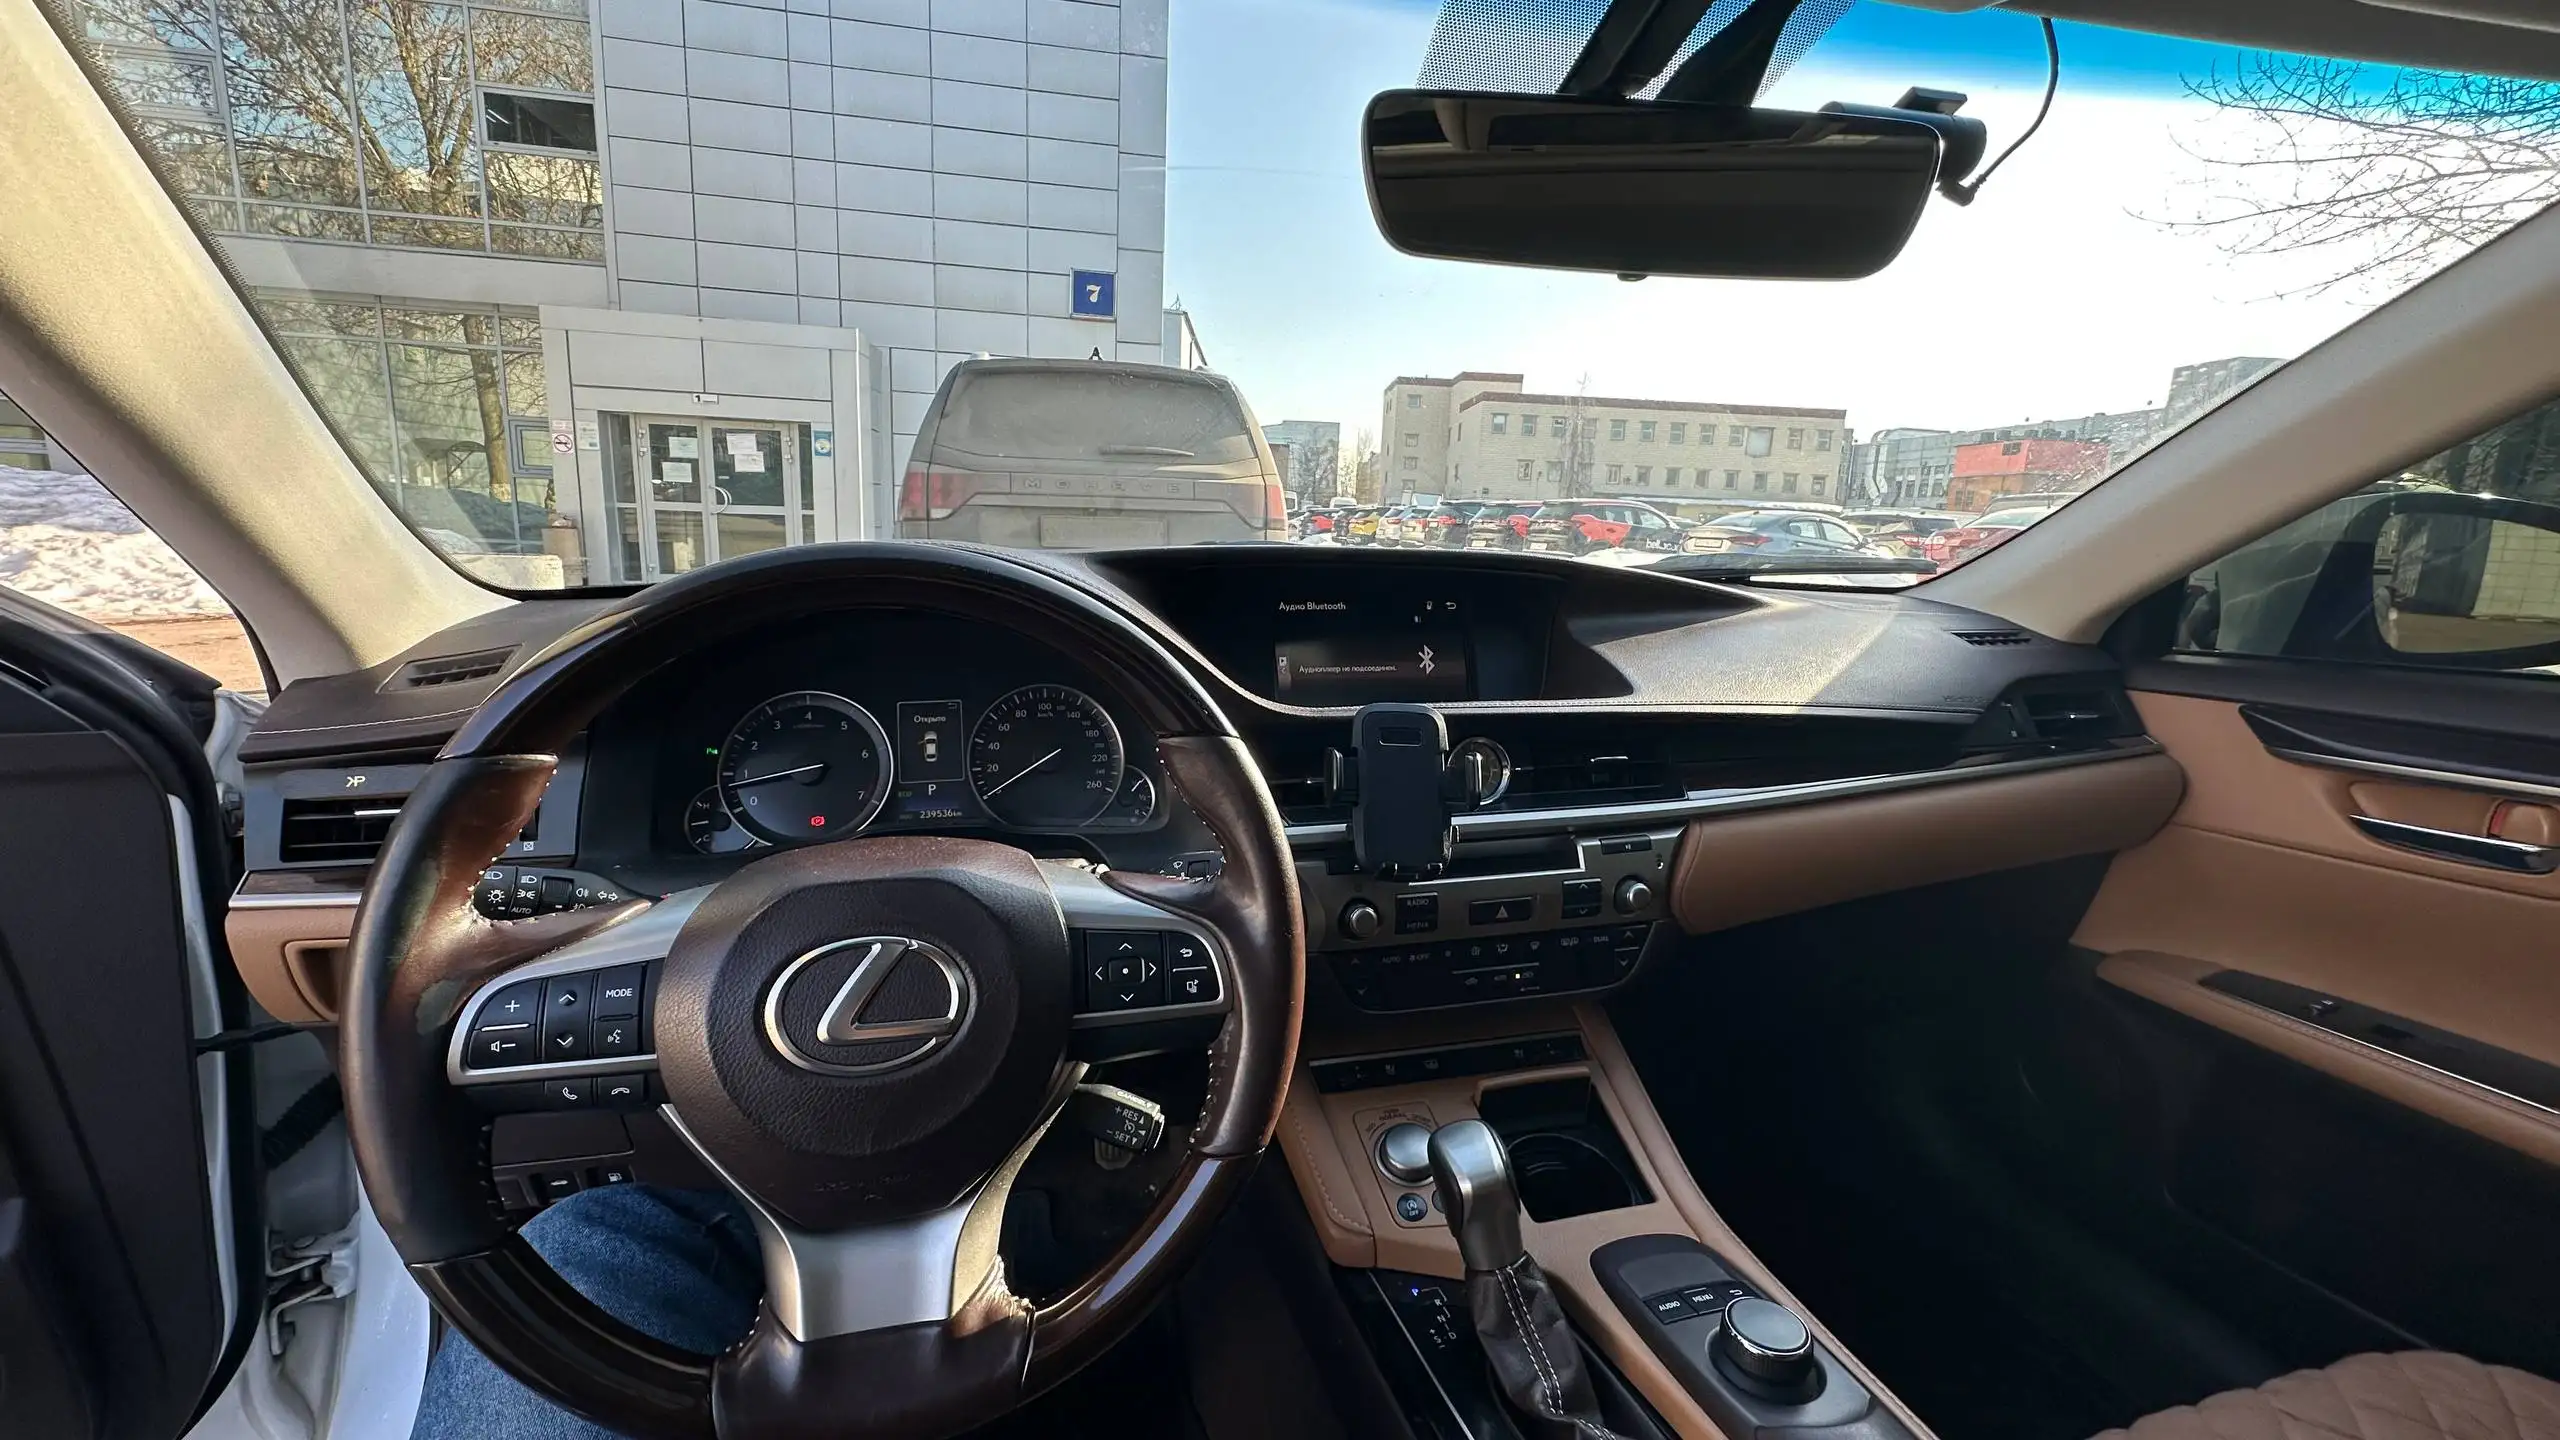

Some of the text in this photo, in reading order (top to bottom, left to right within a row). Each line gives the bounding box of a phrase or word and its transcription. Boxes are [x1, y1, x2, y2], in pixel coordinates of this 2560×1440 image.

[1086, 284, 1102, 303] 7
[1278, 602, 1347, 612] Аудио Bluetooth
[1299, 665, 1341, 674] Аудиоплеер
[1038, 703, 1052, 711] 100
[804, 711, 812, 721] 4
[1015, 709, 1027, 718] 80
[1066, 711, 1080, 719] 140
[913, 714, 947, 723] Открыто
[773, 720, 781, 730] 3
[841, 721, 848, 730] 5
[998, 723, 1010, 732] 60
[1085, 729, 1100, 738] 180
[750, 741, 759, 750] 2
[987, 742, 1000, 750] 40
[861, 749, 869, 759] 6
[1091, 754, 1108, 763] 220
[986, 763, 999, 772] 20
[743, 769, 748, 778] 1
[1086, 780, 1102, 789] 260
[928, 784, 936, 796] P
[858, 791, 865, 800] 7
[750, 796, 758, 806] 0
[1406, 898, 1430, 907] RADIO
[606, 988, 633, 999] MODE
[1122, 1108, 1139, 1122] RES
[1113, 1130, 1131, 1143] SET
[1433, 1298, 1442, 1307] R
[1692, 1293, 1714, 1303] MENU
[1658, 1300, 1681, 1312] AUDIO
